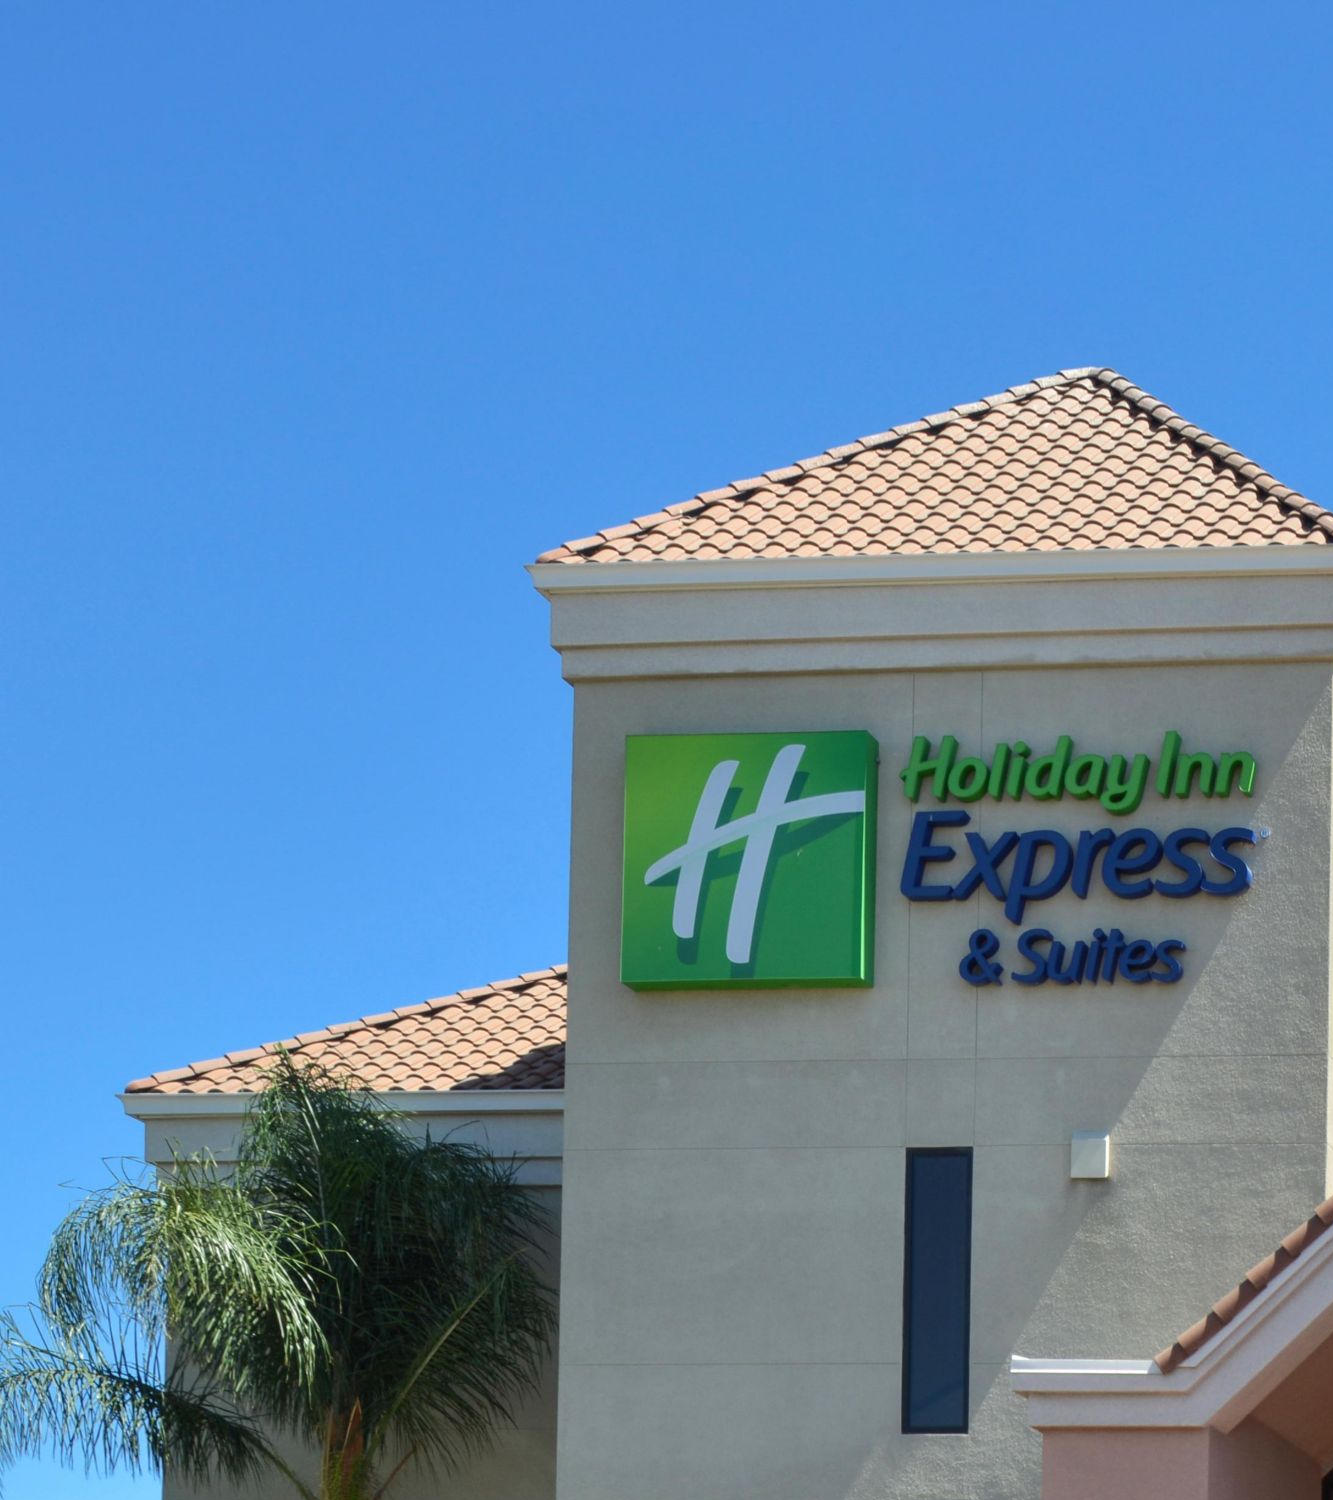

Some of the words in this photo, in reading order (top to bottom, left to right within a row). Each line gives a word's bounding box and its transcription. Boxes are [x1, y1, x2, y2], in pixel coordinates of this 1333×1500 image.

[900, 735, 1149, 815] Holiday
[1155, 730, 1256, 799] Inn
[900, 810, 1256, 925] Express
[958, 928, 1004, 986] &
[1011, 928, 1186, 985] Suites
